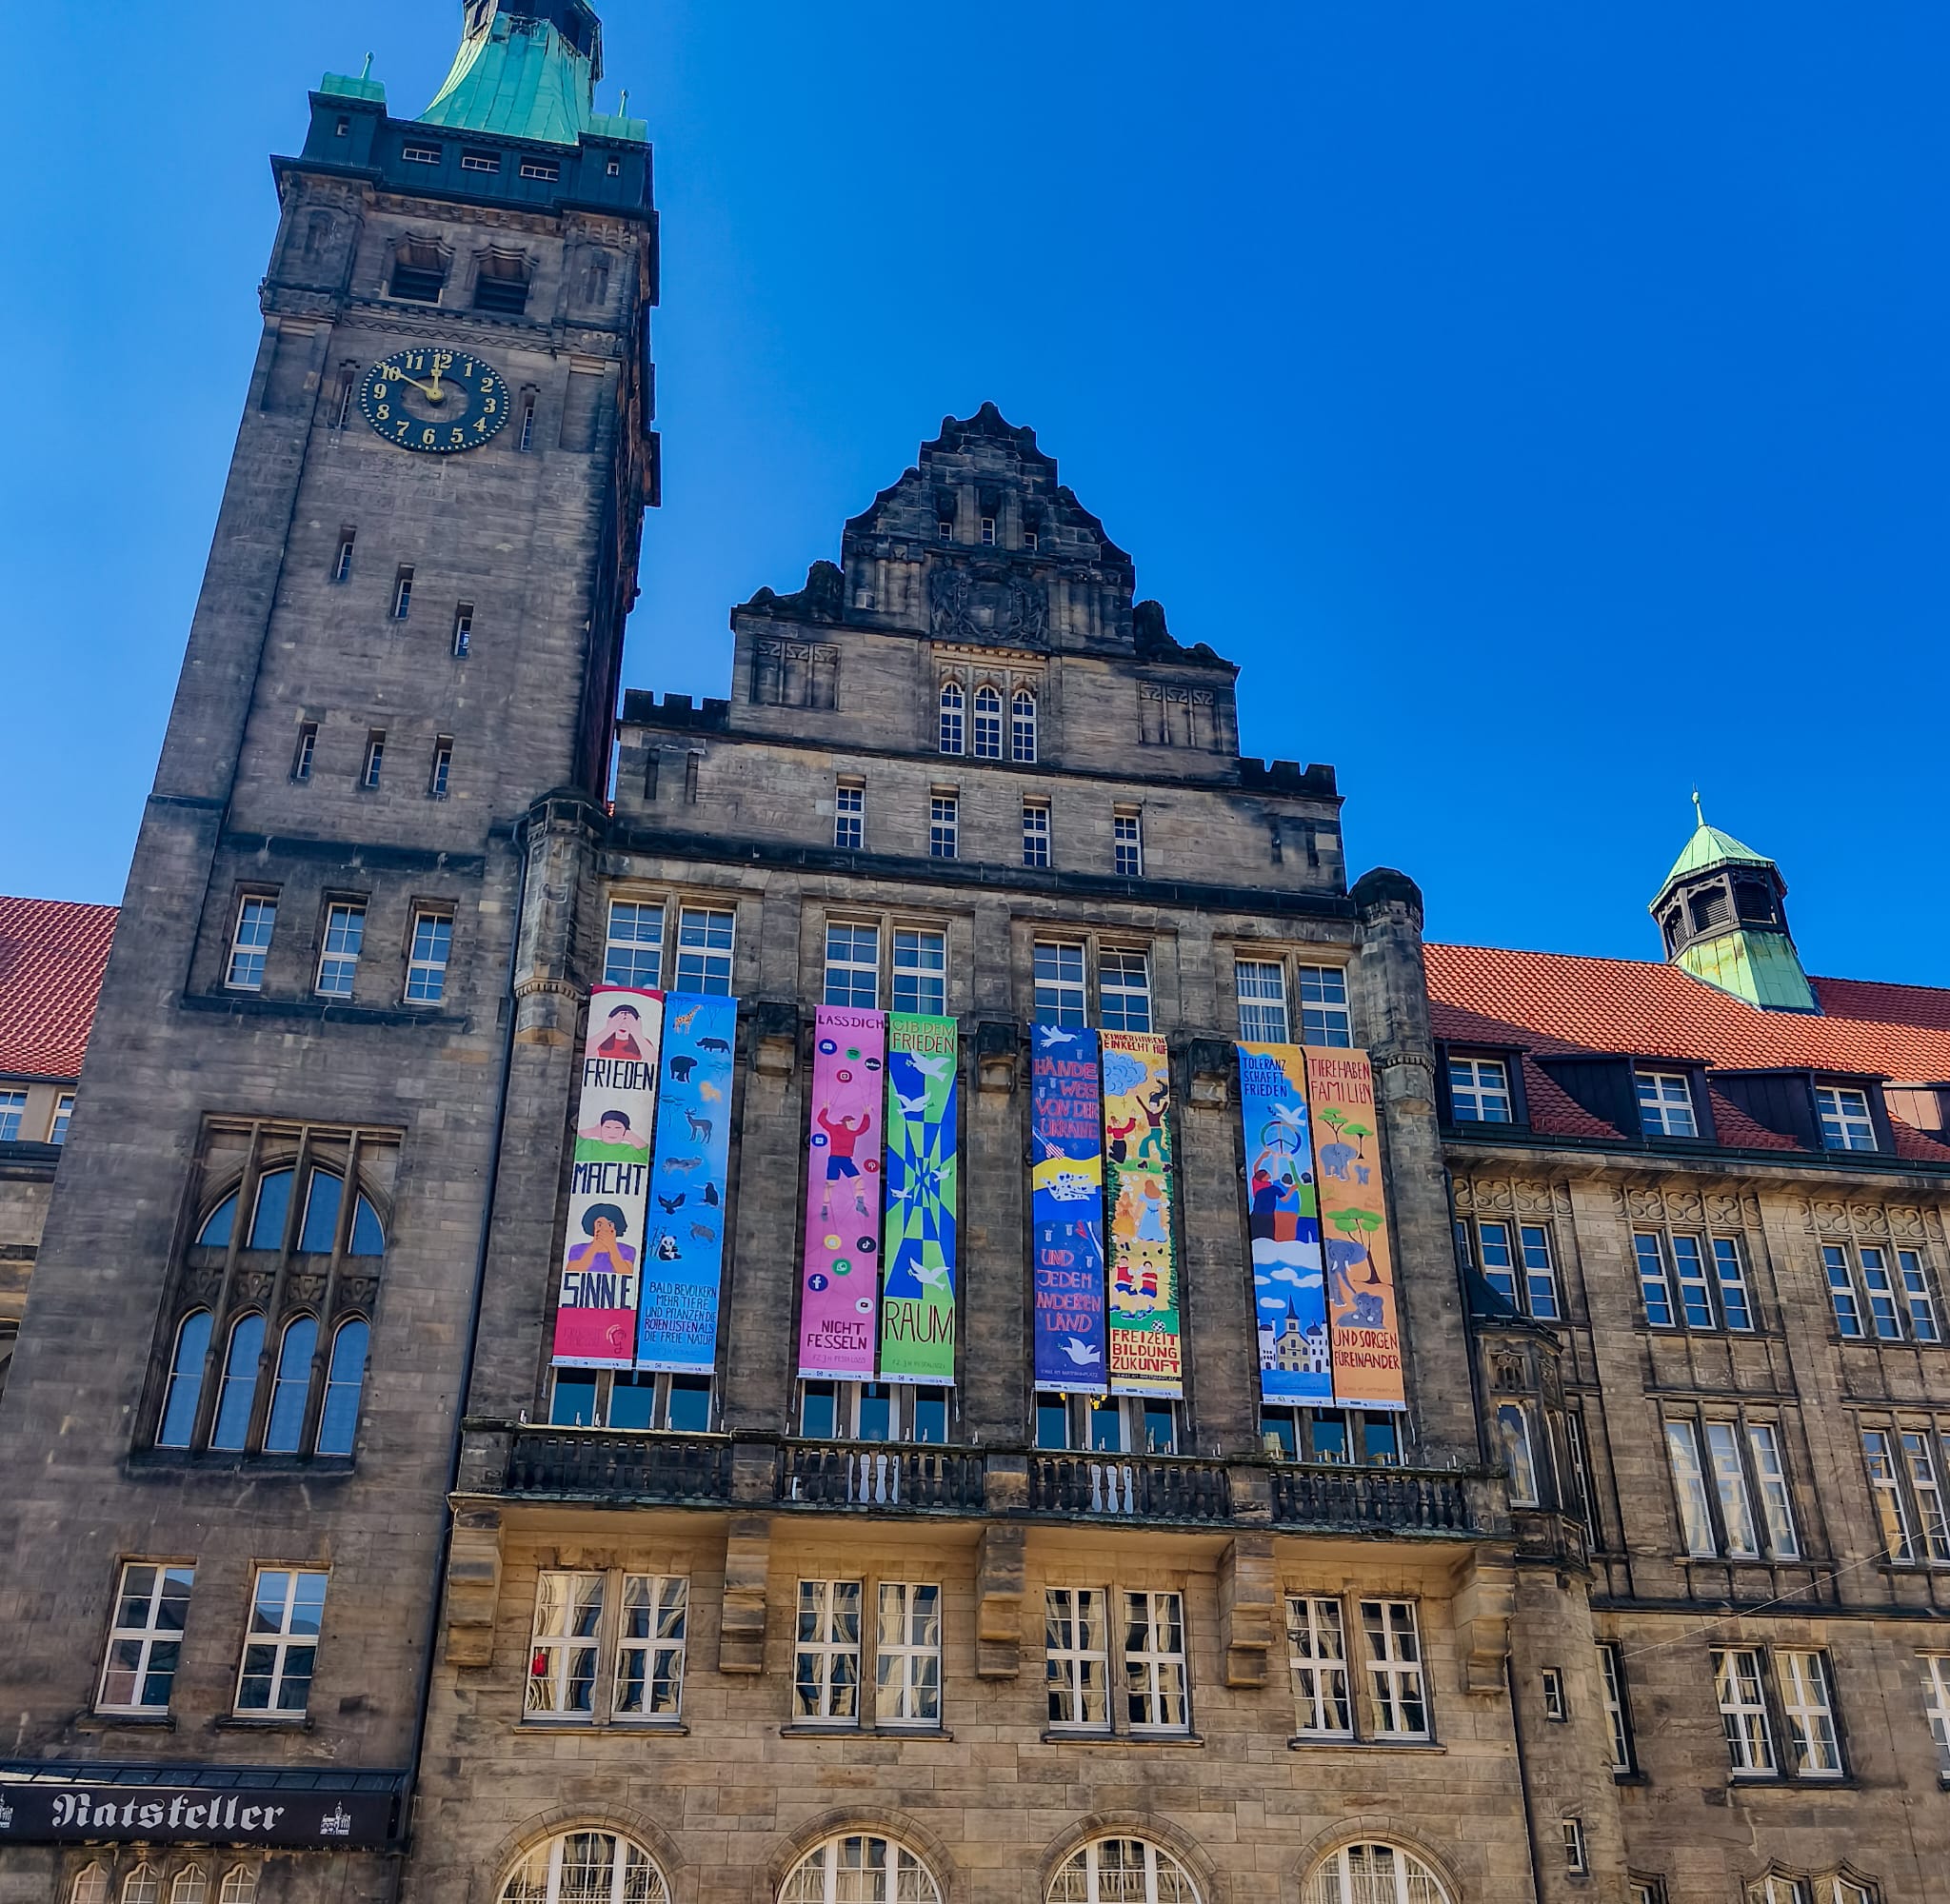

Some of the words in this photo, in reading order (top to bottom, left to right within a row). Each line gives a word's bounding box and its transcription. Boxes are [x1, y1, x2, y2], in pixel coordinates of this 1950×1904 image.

[406, 354, 425, 370] 11
[432, 353, 453, 369] 12
[464, 362, 473, 378] 1
[373, 383, 388, 400] 9
[480, 377, 494, 393] 2
[376, 404, 390, 420] 8
[483, 398, 497, 413] 3
[396, 420, 410, 437] 7
[472, 416, 488, 433] 4
[422, 428, 436, 445] 6
[450, 427, 465, 444] 5
[923, 1021, 956, 1037] DEM
[892, 1032, 955, 1055] FRIEDEN
[1034, 1057, 1098, 1080] HÄNDE
[1243, 1057, 1287, 1072] TOLERANZ
[584, 1059, 654, 1091] FRIEDEN
[1244, 1070, 1284, 1085] SCHAFFT
[1060, 1080, 1098, 1099] WEG
[1244, 1082, 1287, 1098] FRIEDEN
[1311, 1081, 1373, 1105] FAMILIEN
[1035, 1097, 1070, 1117] VON
[571, 1162, 647, 1196] MACHT
[1041, 1248, 1074, 1266] UND
[1037, 1269, 1092, 1289] JEDEM
[649, 1281, 672, 1295] BALD
[656, 1295, 679, 1307] MEHR
[683, 1296, 709, 1310] TIERE
[1036, 1292, 1101, 1312] ANDEREN
[646, 1306, 663, 1319] UND
[821, 1319, 866, 1336] NICHT
[885, 1300, 953, 1345] RAUM
[1045, 1312, 1093, 1333] LAND
[645, 1331, 656, 1342] DIE
[660, 1331, 683, 1344] FREIE
[686, 1333, 714, 1346] NATUR
[806, 1333, 867, 1350] FESSELN
[1112, 1328, 1179, 1346] FREIZEIT
[1333, 1328, 1358, 1347] UND
[1360, 1330, 1398, 1350] SORGEN
[1112, 1343, 1178, 1359] BILDUNG
[1111, 1356, 1181, 1374] ZUKUNFT
[51, 1792, 285, 1832] Ratskeller
